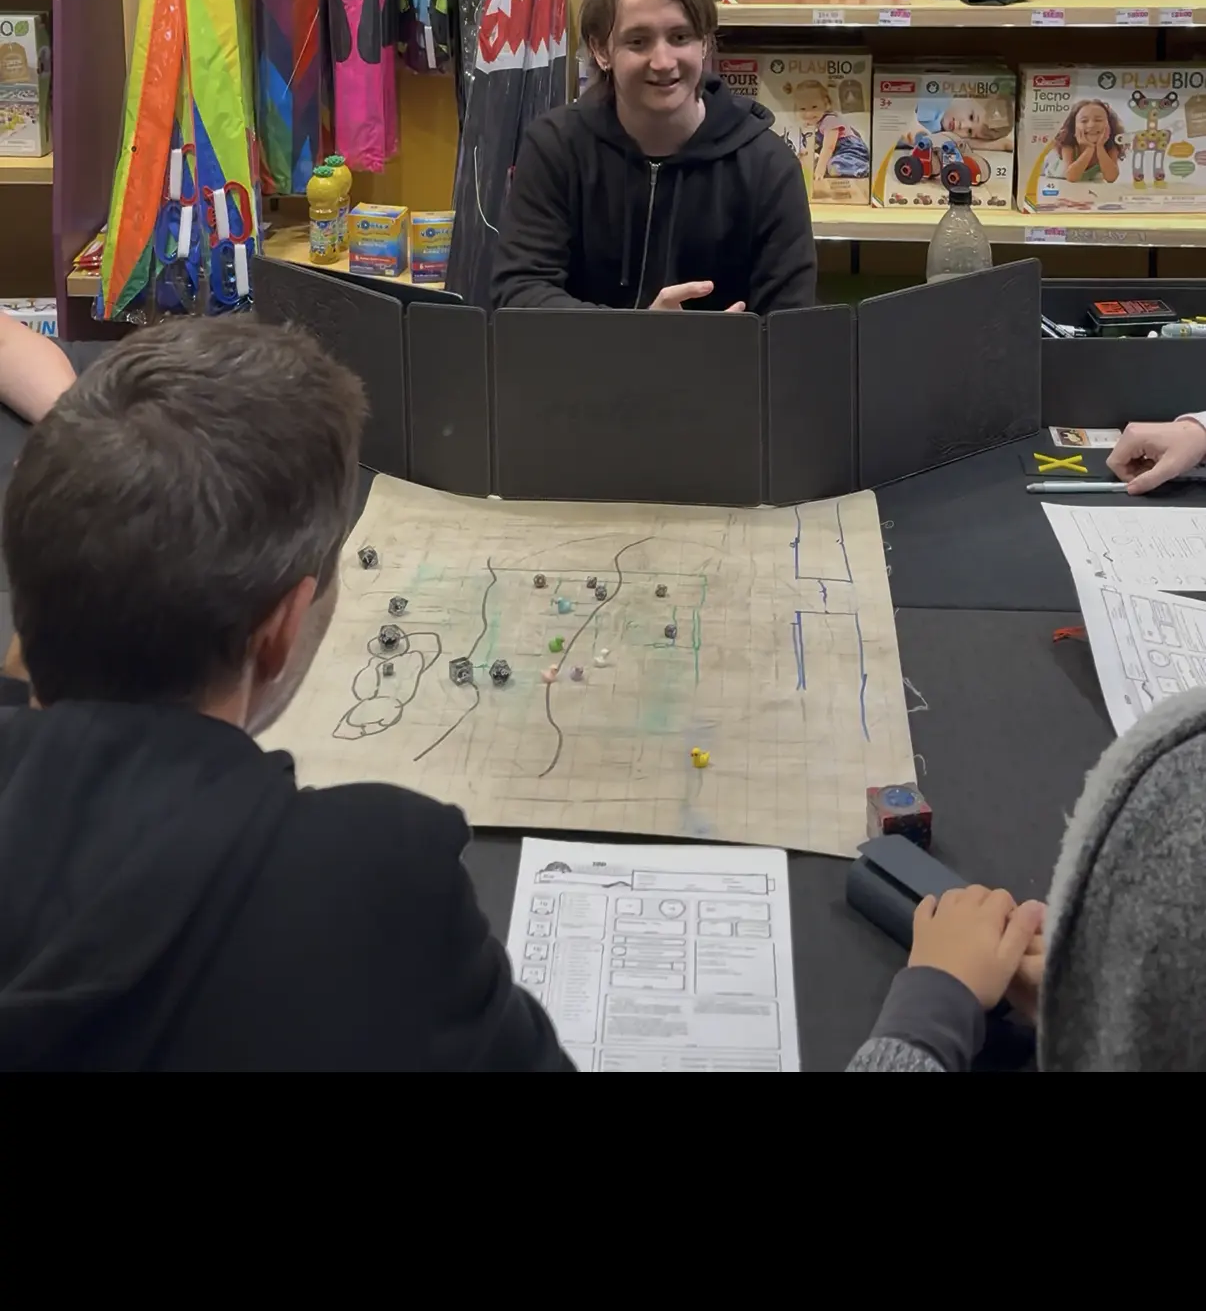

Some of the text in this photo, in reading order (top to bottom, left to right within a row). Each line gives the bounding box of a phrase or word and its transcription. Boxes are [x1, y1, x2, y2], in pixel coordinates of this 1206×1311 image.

[788, 60, 853, 75] PLAYBIO
[1121, 71, 1205, 89] PLAYBIO
[942, 80, 1000, 94] PLAYBIO
[1032, 89, 1070, 101] Tecno
[880, 98, 892, 107] 3+
[1032, 102, 1070, 112] Jumbo
[995, 167, 1006, 176] 32
